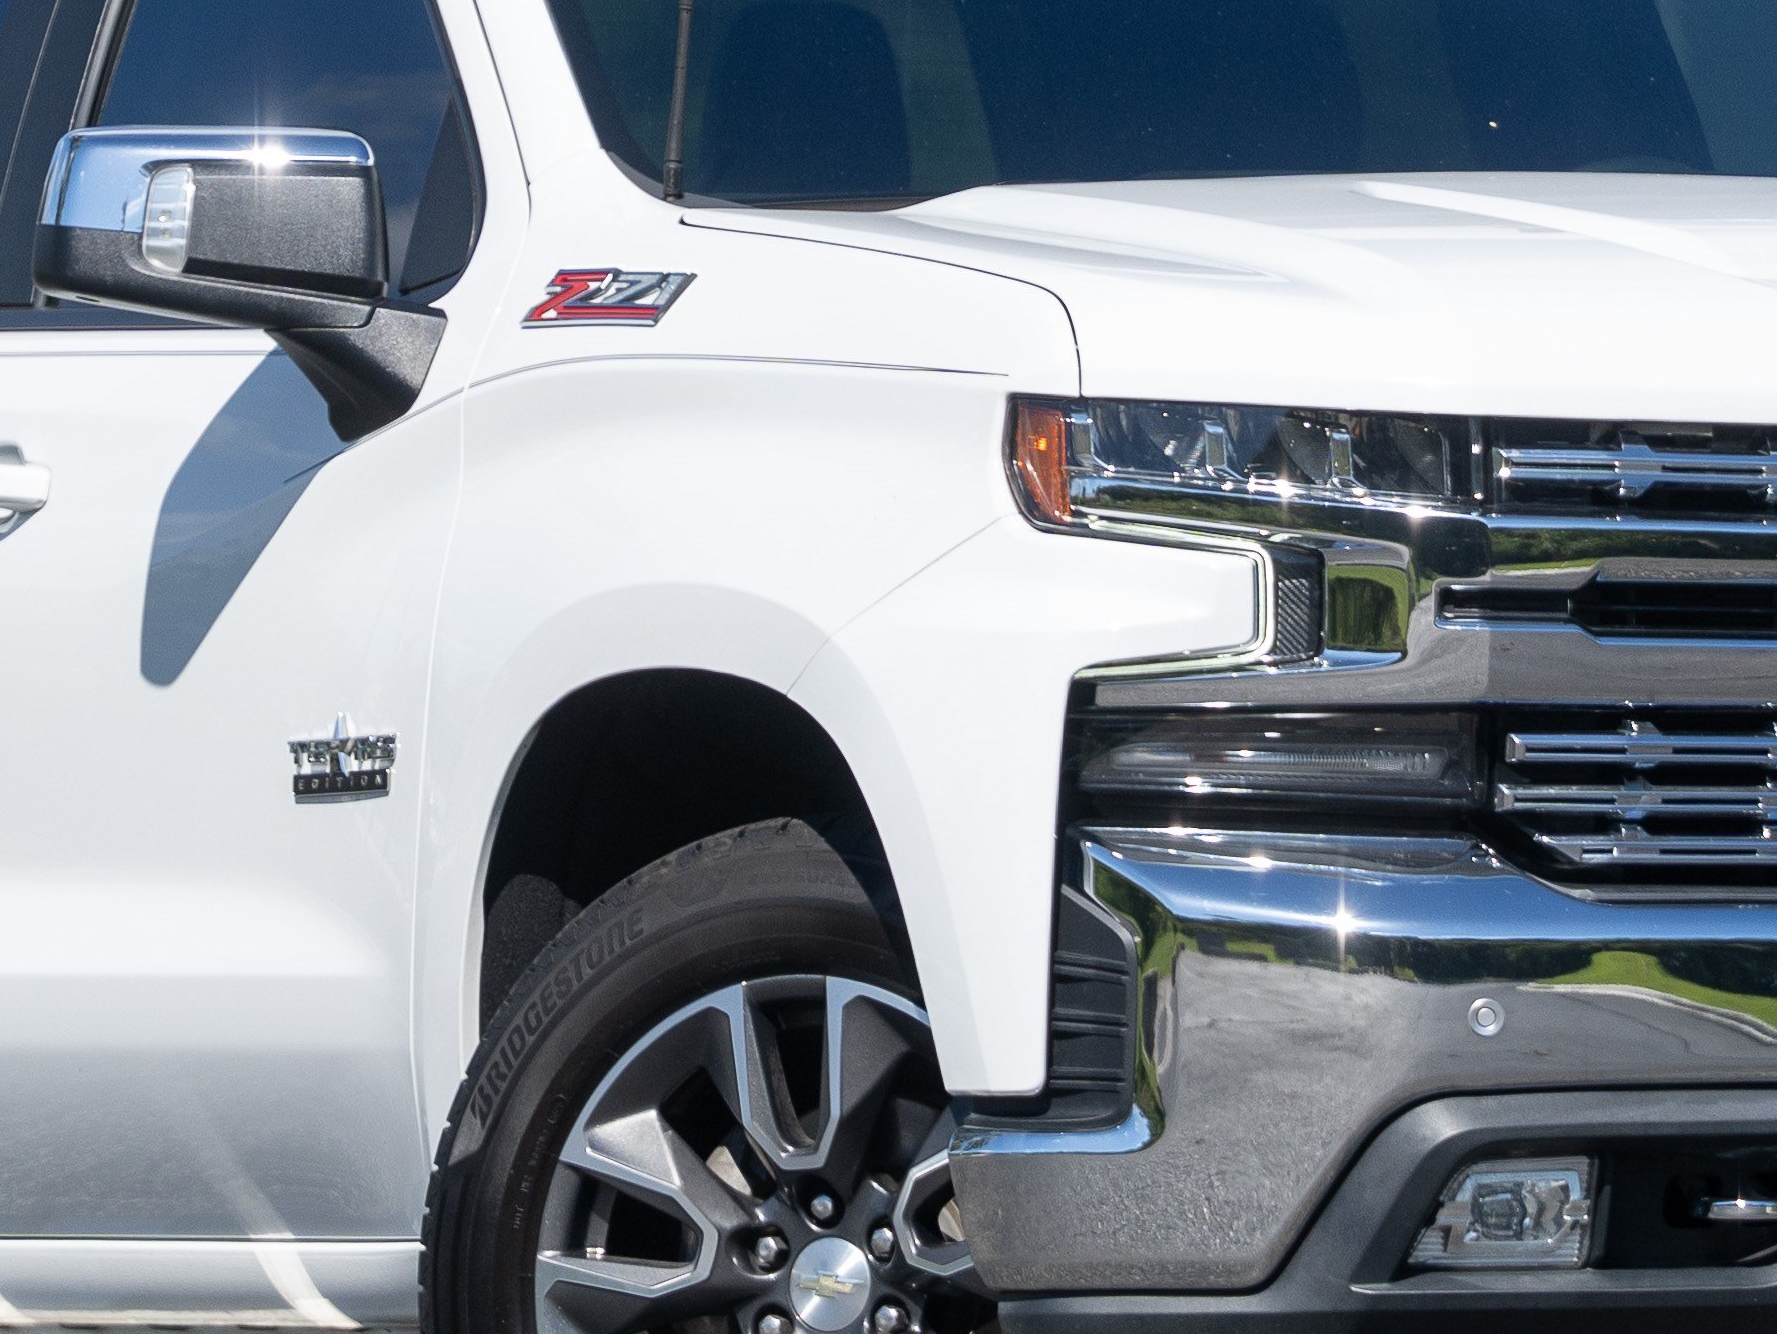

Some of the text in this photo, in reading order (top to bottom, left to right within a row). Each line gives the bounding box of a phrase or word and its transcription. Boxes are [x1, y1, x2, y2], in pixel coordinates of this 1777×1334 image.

[521, 268, 698, 329] Z71
[295, 770, 386, 793] EDITION
[468, 907, 646, 1134] BRIDGESTONE
